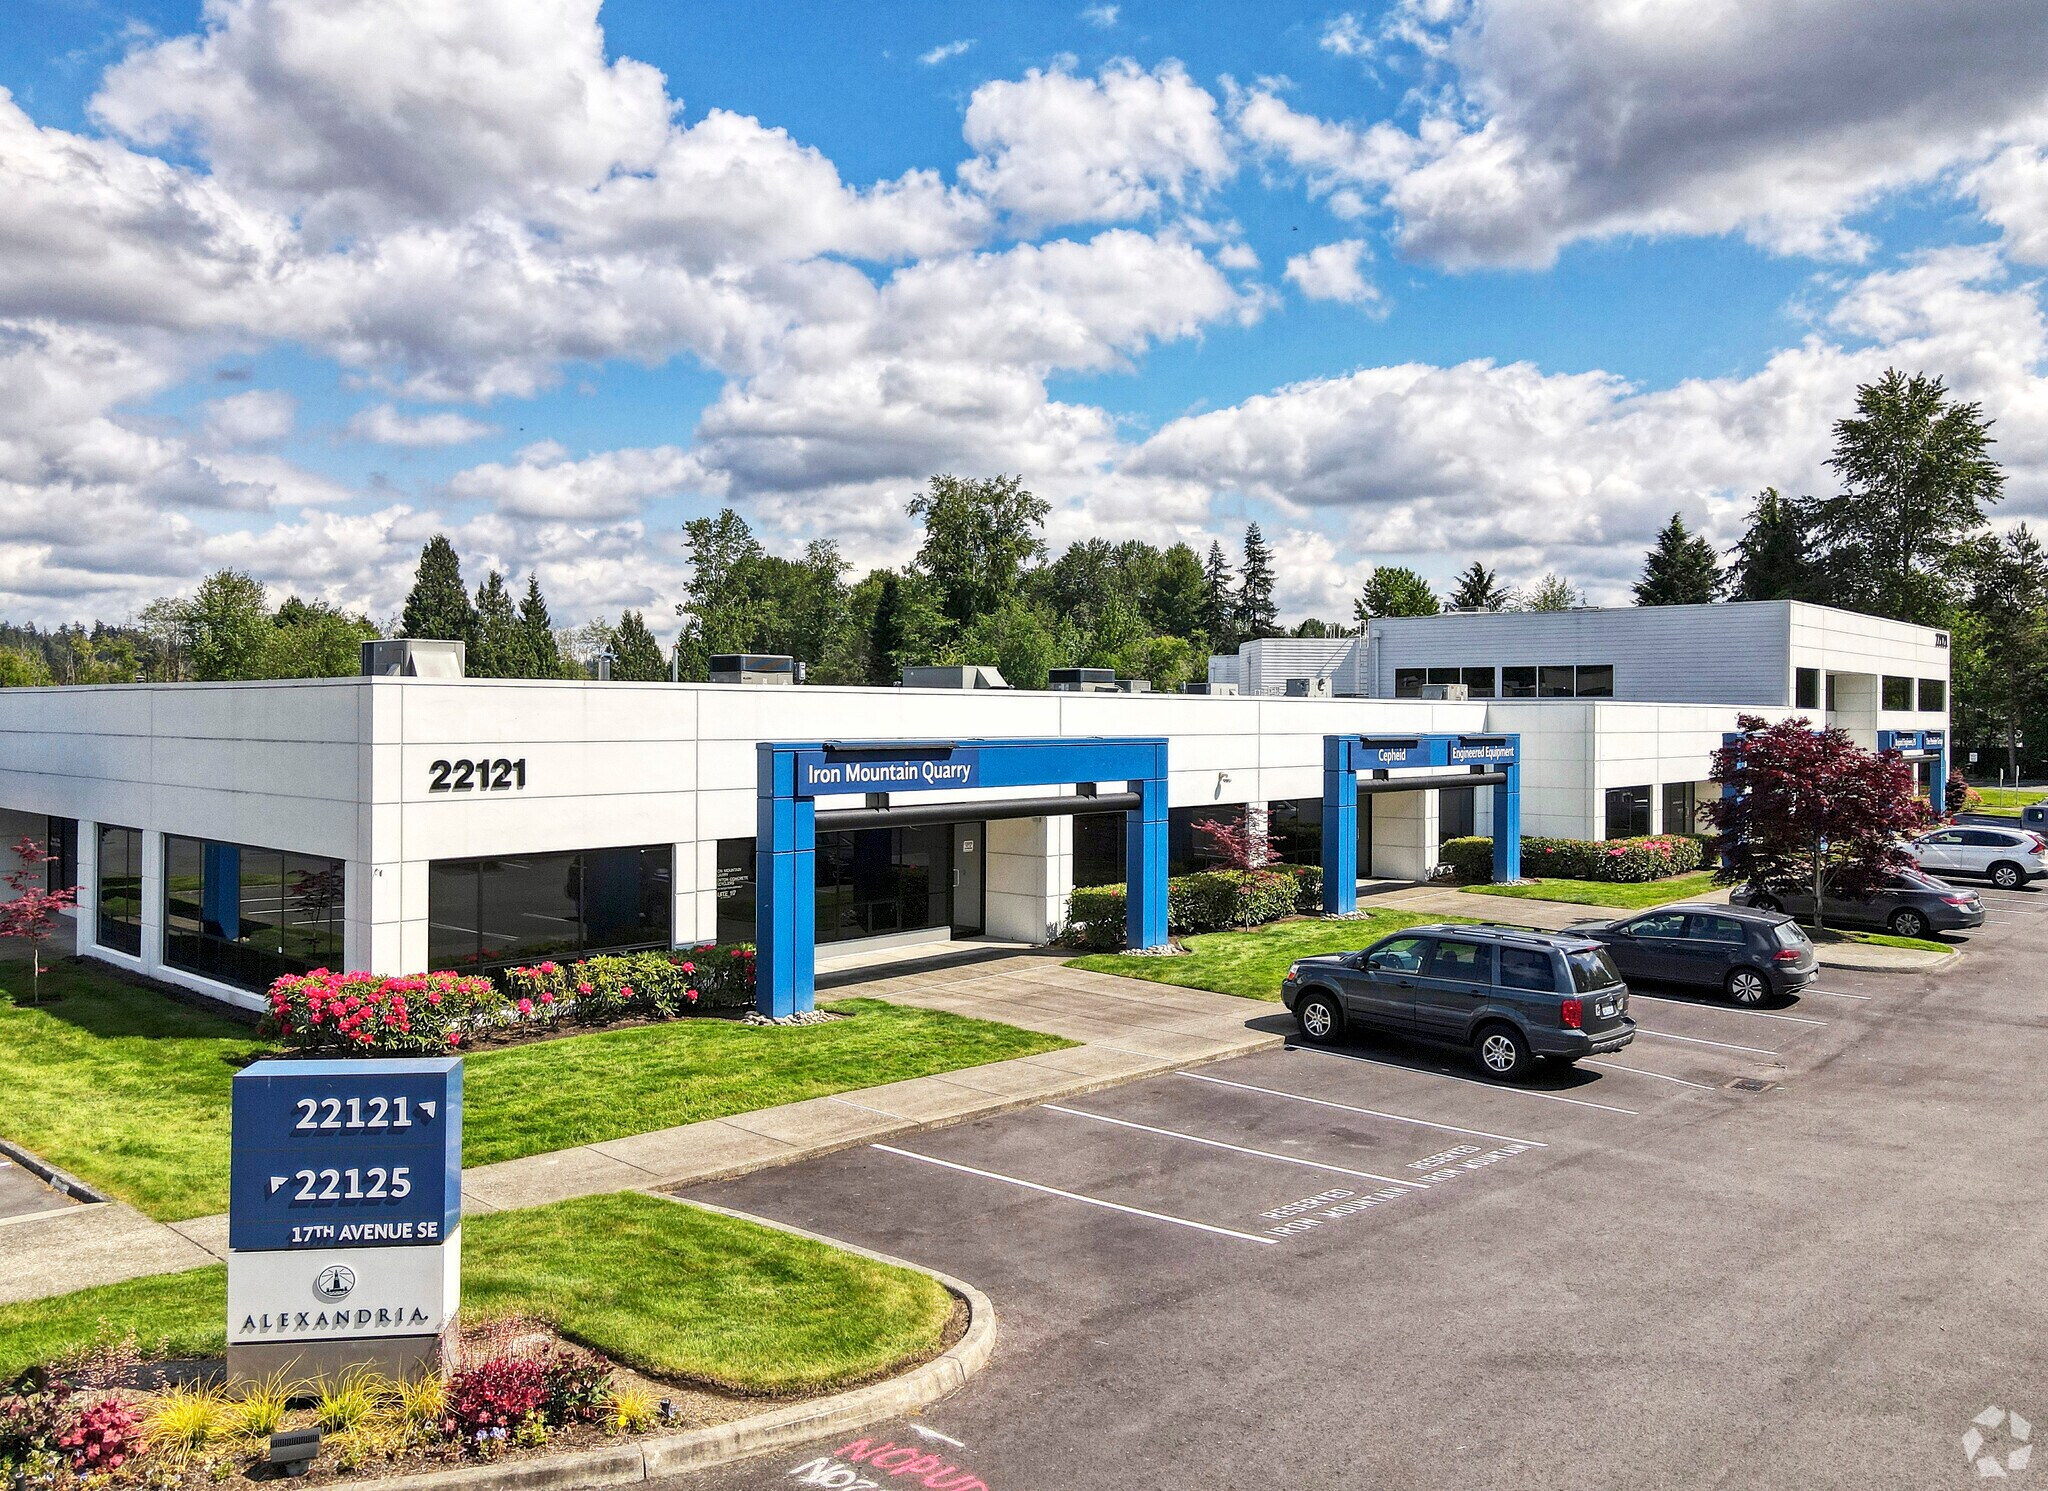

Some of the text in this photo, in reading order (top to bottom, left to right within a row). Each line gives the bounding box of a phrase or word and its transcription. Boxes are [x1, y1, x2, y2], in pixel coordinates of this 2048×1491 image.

[1378, 748, 1406, 764] Cepheid
[1452, 746, 1514, 762] Engineered Equipment
[429, 759, 526, 793] 22121
[808, 761, 971, 785] Iron Mountain Quarry
[296, 1096, 412, 1129] 22121
[1405, 1144, 1481, 1170] RESERVED
[1417, 1144, 1531, 1184] IRON MOUNTAIN
[294, 1167, 411, 1200] 22125
[1259, 1188, 1355, 1220] RESERVED
[1264, 1186, 1412, 1237] IRON MOUNTAIN
[292, 1222, 438, 1243] 17TH AVENUE SE
